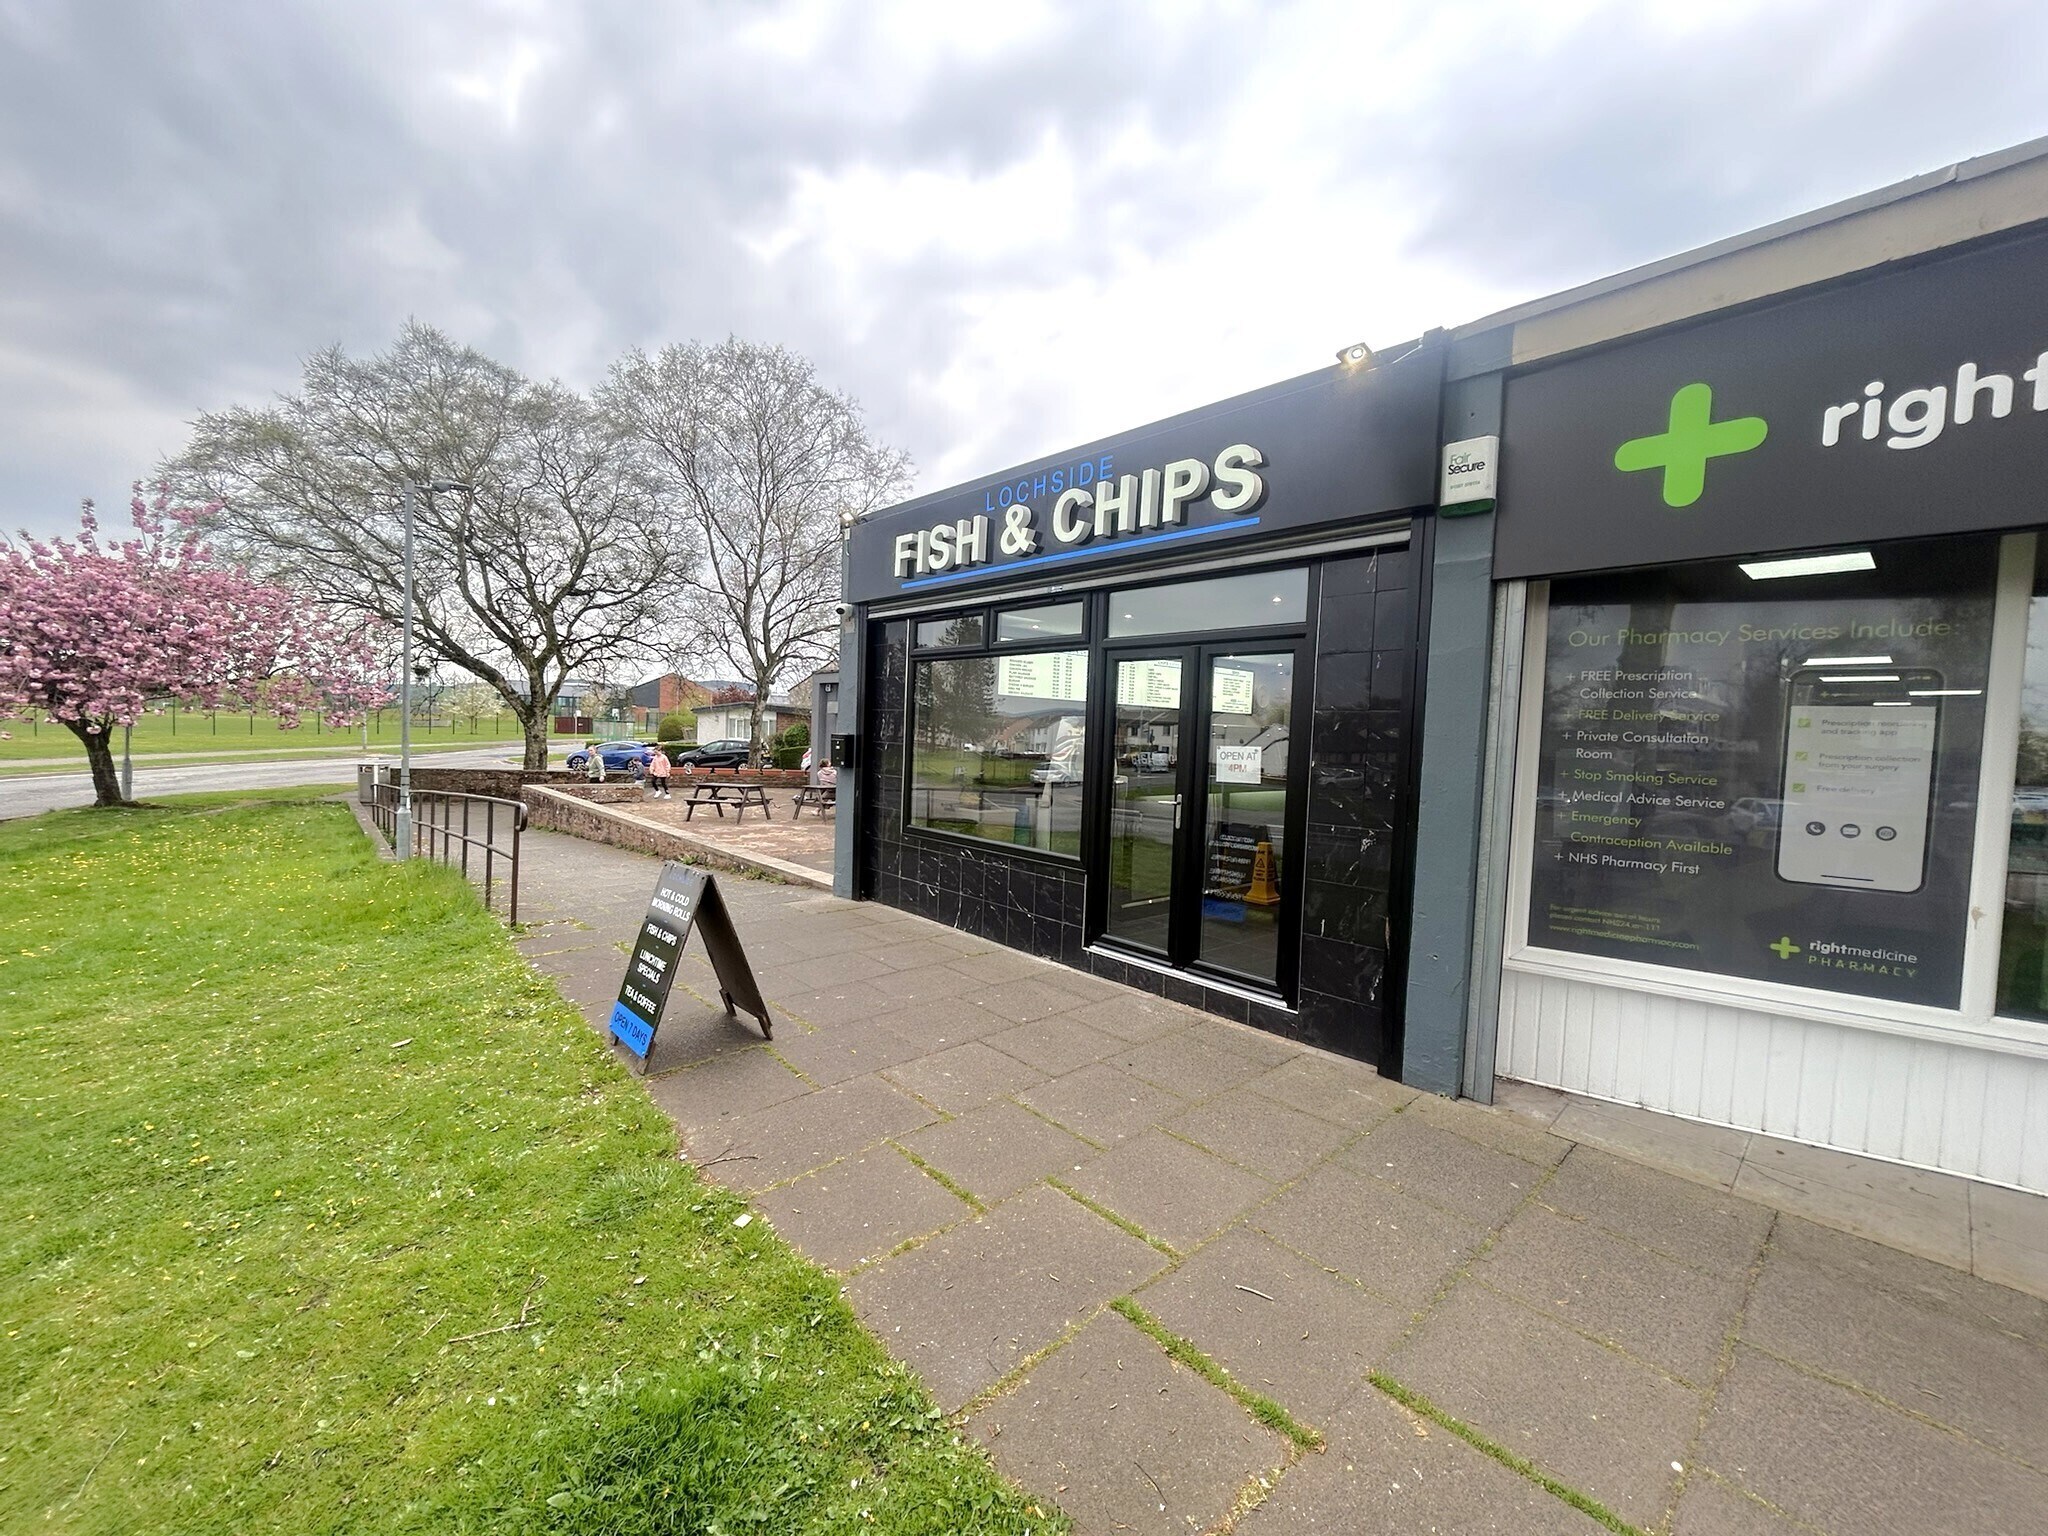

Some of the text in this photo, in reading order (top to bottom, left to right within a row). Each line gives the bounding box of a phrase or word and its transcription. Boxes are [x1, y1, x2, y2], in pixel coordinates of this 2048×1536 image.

[1822, 351, 2048, 450] right
[1448, 461, 1486, 475] Secure
[985, 455, 1114, 511] LOCHSIDE
[894, 443, 1265, 578] FISH & CHIPS
[1568, 630, 1610, 647] Our
[1617, 628, 1731, 646] Pharmacy
[1738, 623, 1840, 643] Services
[1580, 669, 1693, 683] FREE Prescription
[1580, 688, 1696, 699] Collection Service
[1578, 709, 1720, 723] FREE Delivery ervice
[1576, 731, 1709, 744] Private Consultation
[1220, 751, 1257, 760] OPEN AT
[1576, 748, 1612, 759] Room
[1228, 764, 1247, 773] 4PM
[1574, 769, 1718, 786] Stop Smoking Service
[1572, 790, 1725, 809] Medical Advice Service
[1571, 810, 1643, 828] Emergency
[1570, 831, 1733, 855] Contraception Available
[1568, 852, 1700, 875] NHS Pharmacy First
[660, 887, 672, 899] HOT
[675, 893, 690, 907] COLD
[651, 896, 691, 922] MORNING ROLLS
[646, 923, 660, 937] FISH
[661, 930, 678, 947] CHIPS
[639, 949, 668, 973] LUNCHTIME
[1809, 940, 1918, 964] rightmedicine
[637, 962, 661, 984] SPECIALS
[1808, 955, 1917, 978] PHARMACY
[624, 984, 634, 999] TEA
[636, 993, 657, 1015] COFFEE
[614, 1011, 648, 1046] OPEN 7 DAYS
